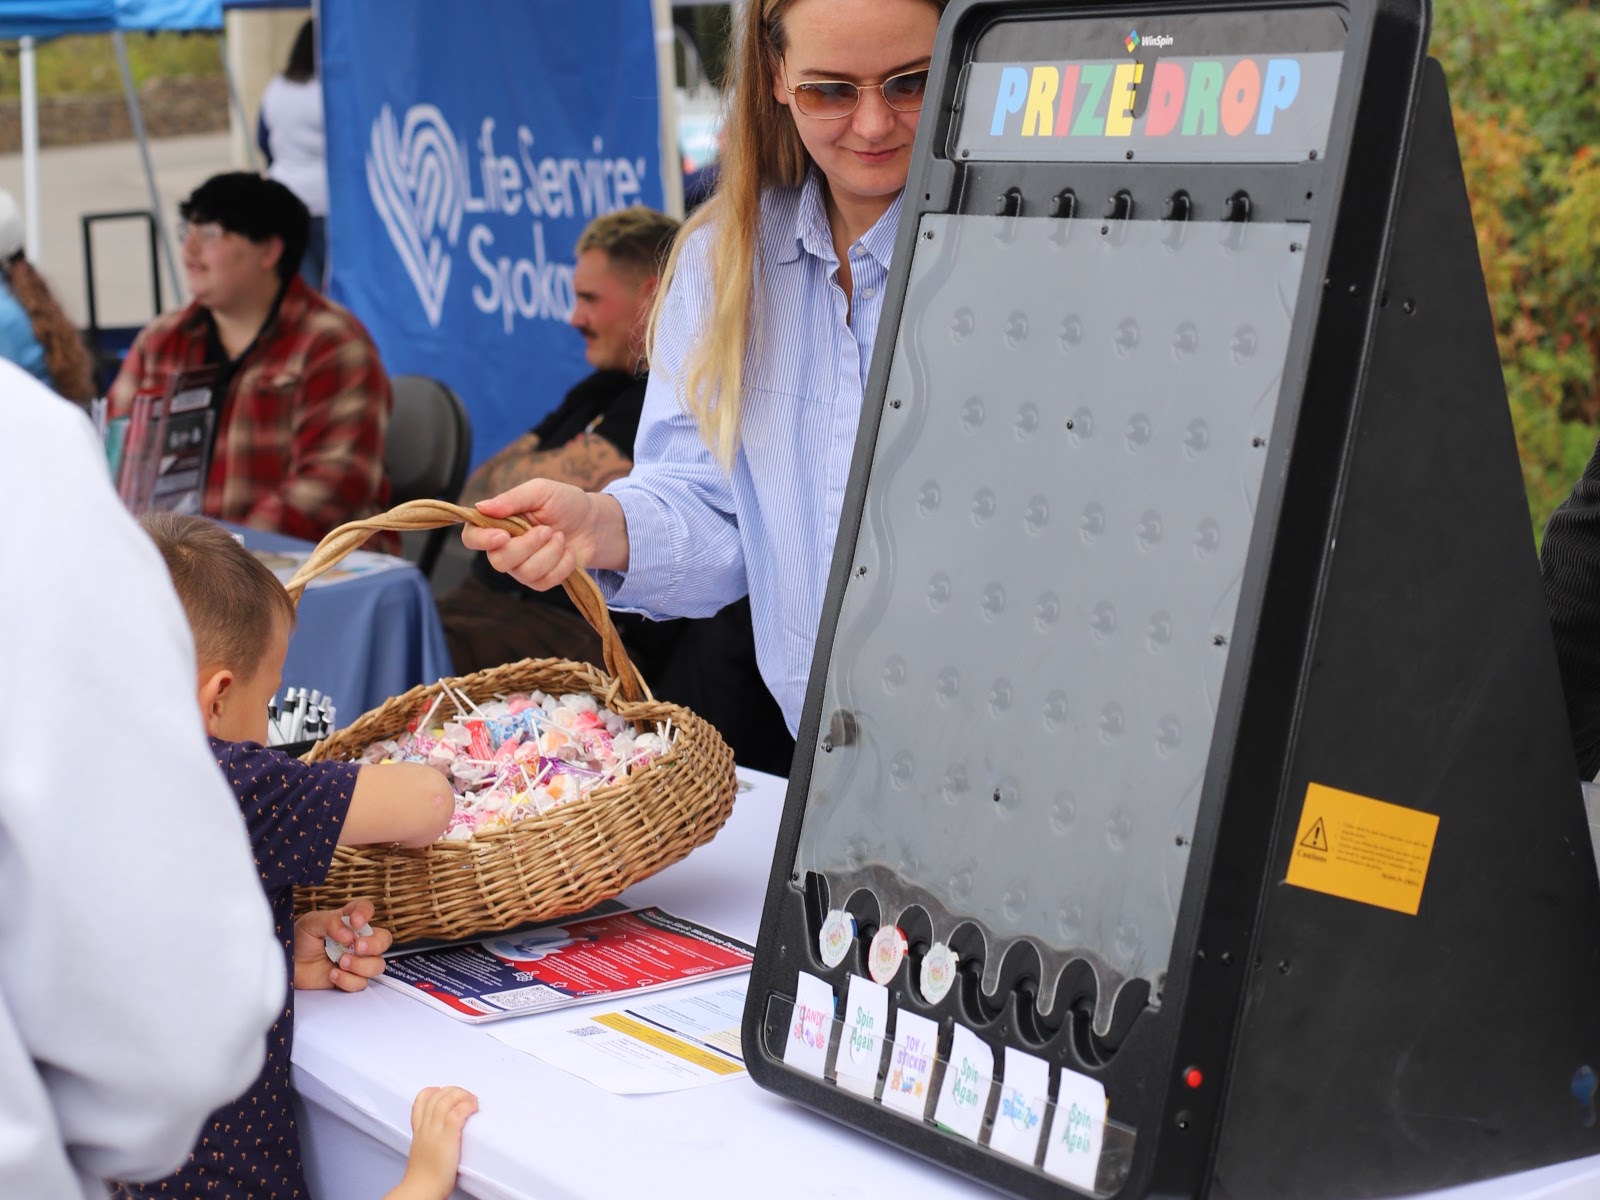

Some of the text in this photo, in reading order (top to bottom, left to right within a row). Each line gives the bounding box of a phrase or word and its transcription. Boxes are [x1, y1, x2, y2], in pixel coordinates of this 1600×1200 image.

[1141, 34, 1174, 49] WinSpin
[989, 58, 1301, 137] PRIZE DROP
[467, 220, 578, 335] Spoka
[799, 1005, 826, 1027] CANDY
[855, 1005, 875, 1029] Spin
[851, 1027, 875, 1053] Again
[906, 1034, 920, 1049] TOY
[896, 1050, 927, 1075] STICKER
[960, 1056, 979, 1081] Spin
[953, 1077, 979, 1107] Again
[1069, 1102, 1092, 1130] Spin
[1062, 1125, 1091, 1154] Again
